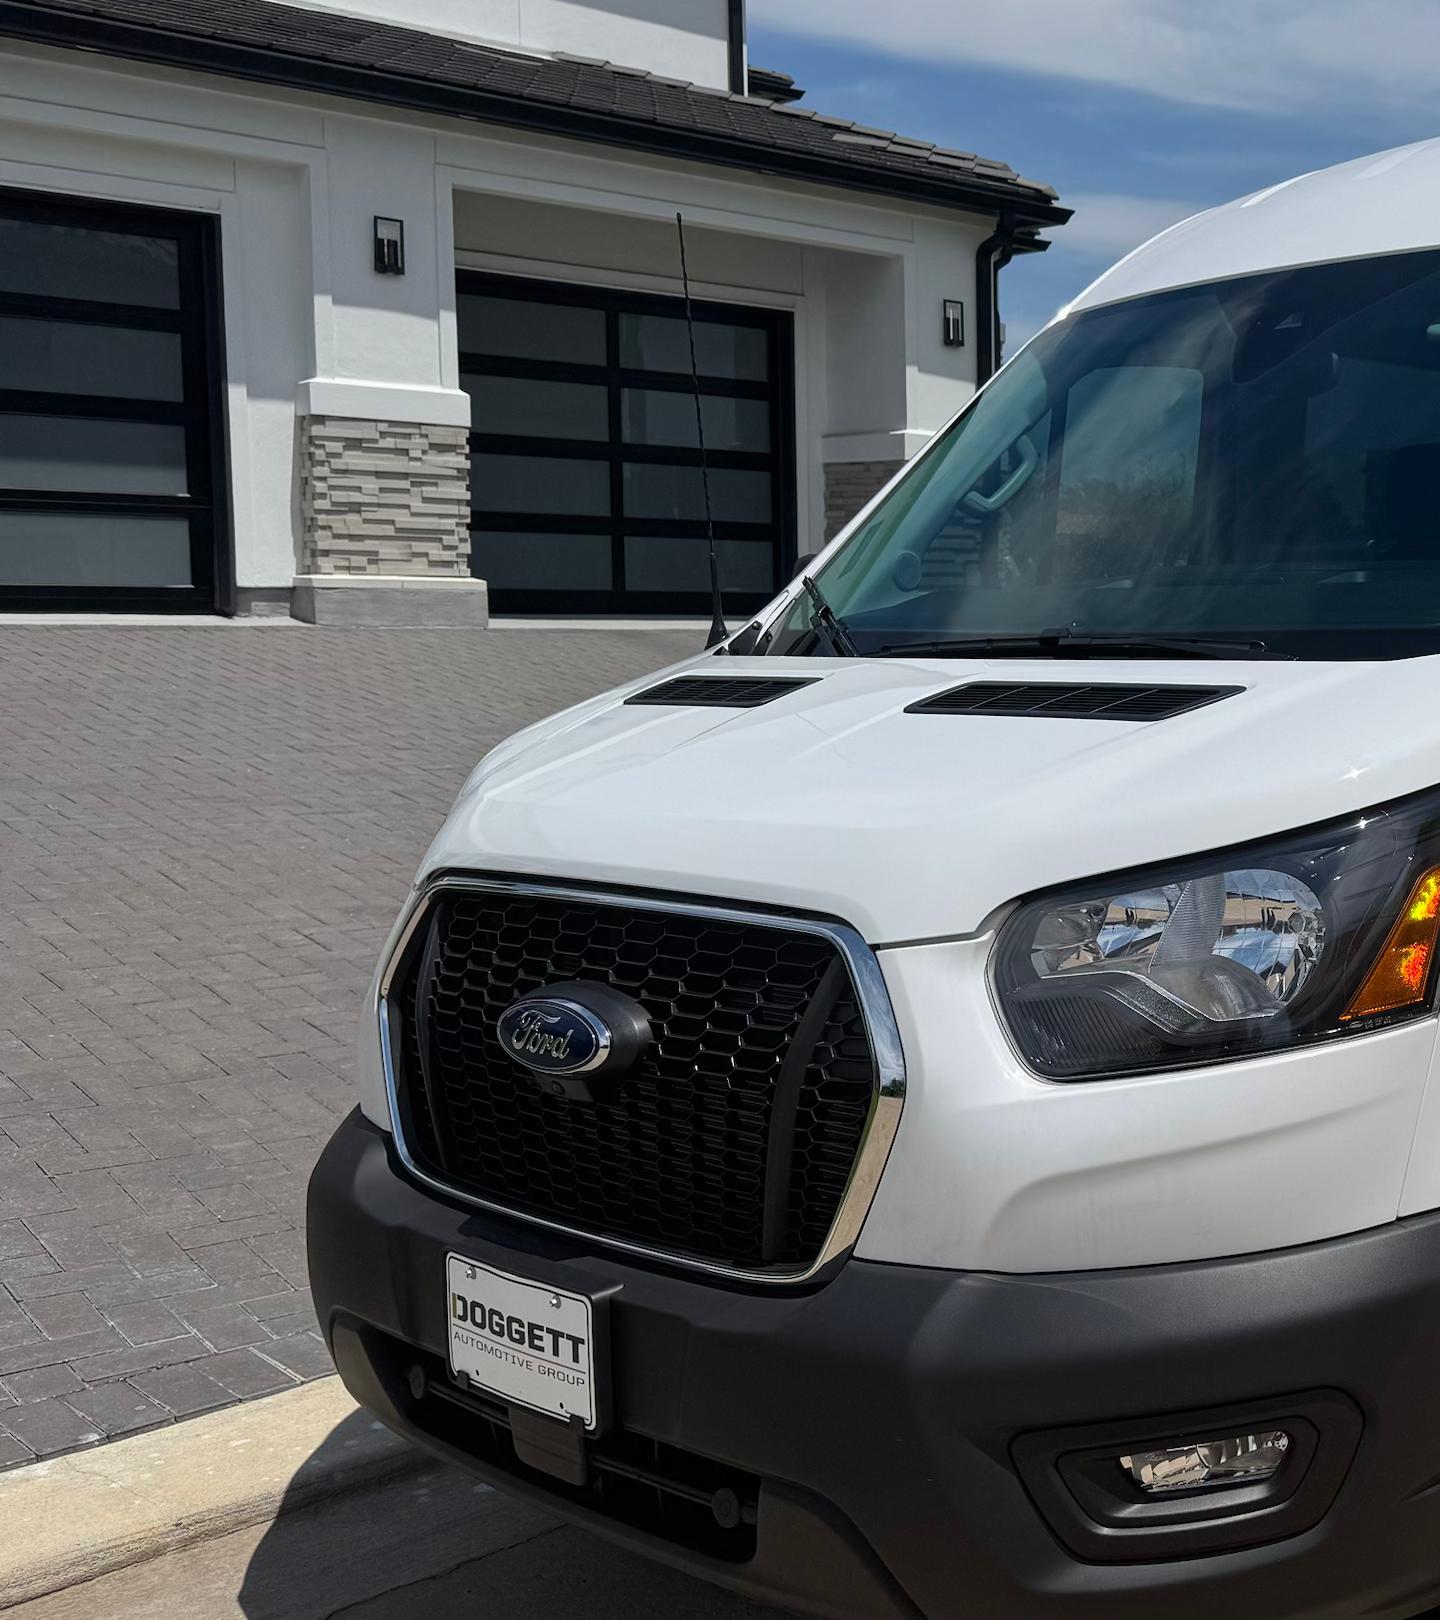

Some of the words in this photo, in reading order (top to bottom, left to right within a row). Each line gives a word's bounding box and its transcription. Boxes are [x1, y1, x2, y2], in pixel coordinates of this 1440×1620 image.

[511, 1009, 575, 1060] Ford
[452, 1292, 585, 1364] DOGGETT
[453, 1330, 534, 1371] AUTOMOTIVE
[538, 1364, 585, 1387] GROUP
